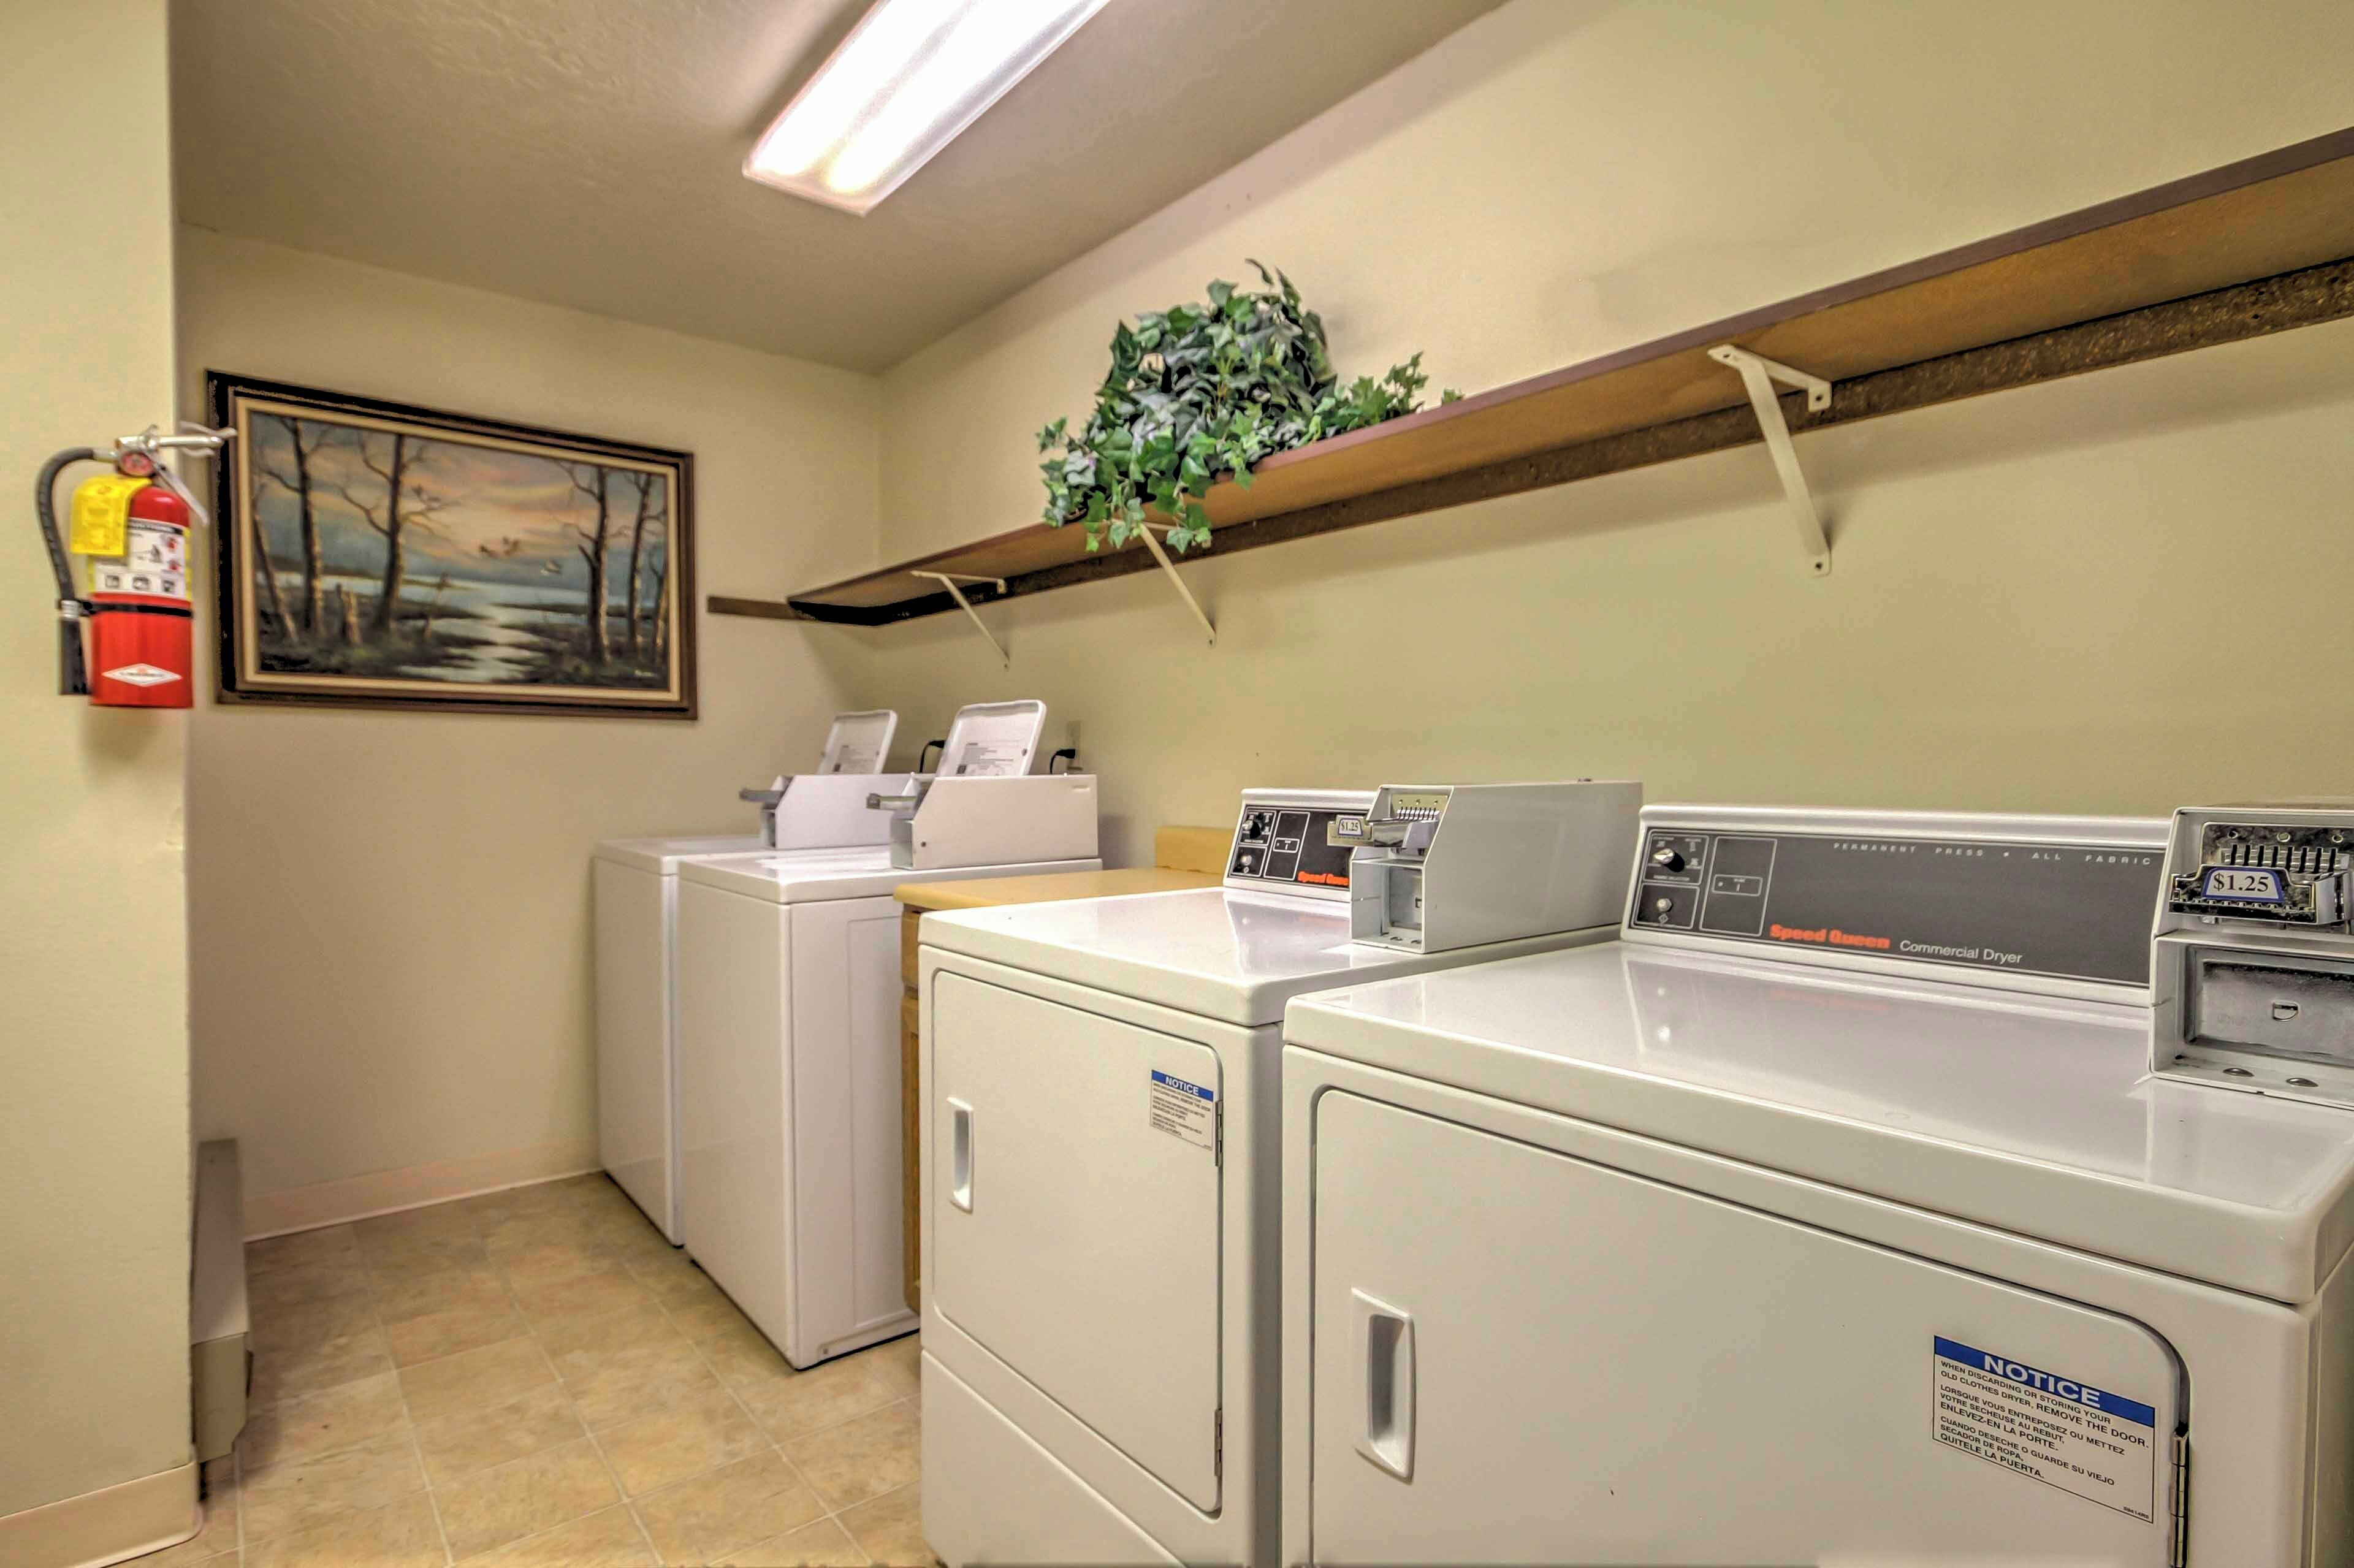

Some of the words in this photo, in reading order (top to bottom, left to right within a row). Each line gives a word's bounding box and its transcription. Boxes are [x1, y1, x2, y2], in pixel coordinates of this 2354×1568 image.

[1341, 821, 1359, 831] $1.25
[1935, 847, 1984, 857] PRESS
[2032, 852, 2061, 861] ALL
[2085, 854, 2150, 865] FABRIC
[2213, 872, 2269, 892] $1.25
[1770, 923, 1827, 942] Speed
[1829, 929, 1891, 950] Queen
[1900, 940, 1979, 959] Commercial
[1983, 948, 2023, 965] Dryer
[1165, 1076, 1199, 1095] NOTICE
[1941, 1360, 1966, 1374] WHEN
[1968, 1370, 2021, 1393] DISCARDING
[2024, 1390, 2037, 1399] OR
[2040, 1395, 2081, 1414] STORING
[2082, 1409, 2111, 1425] YOUR
[1984, 1355, 2101, 1408] NOTICE
[1940, 1393, 1967, 1407] VOTRE
[1970, 1403, 2016, 1425] SECHEUSE
[2018, 1421, 2030, 1430] AU
[2033, 1426, 2065, 1444] REBUT,
[1940, 1384, 1980, 1403] LORSQUE
[1982, 1399, 2006, 1413] VOUS
[2008, 1408, 2068, 1435] ENTREPOSEZ
[2070, 1431, 2084, 1441] OU
[2086, 1436, 2125, 1456] METTEZ
[1941, 1371, 1957, 1381] OLD
[1960, 1377, 1999, 1396] CLOTHES
[2036, 1403, 2083, 1425] REMOVE
[2085, 1420, 2108, 1434] THE
[2111, 1429, 2149, 1448] DOOR.
[1941, 1401, 2000, 1429] ENLEVEZ-EN
[2004, 1425, 2016, 1436] LA
[2019, 1431, 2059, 1451] PORTE.
[1940, 1424, 1981, 1444] SECADOR
[1983, 1441, 1995, 1450] DE
[1940, 1416, 1976, 1434] CUANDO
[1978, 1429, 2019, 1450] DESECHE
[2031, 1450, 2070, 1469] GUARDE
[2071, 1464, 2084, 1475] SU
[2087, 1471, 2115, 1486] VIEJO
[1941, 1433, 1982, 1454] QUITELE
[1984, 1449, 1997, 1460] LA
[2000, 1456, 2044, 1479] PUERTA.
